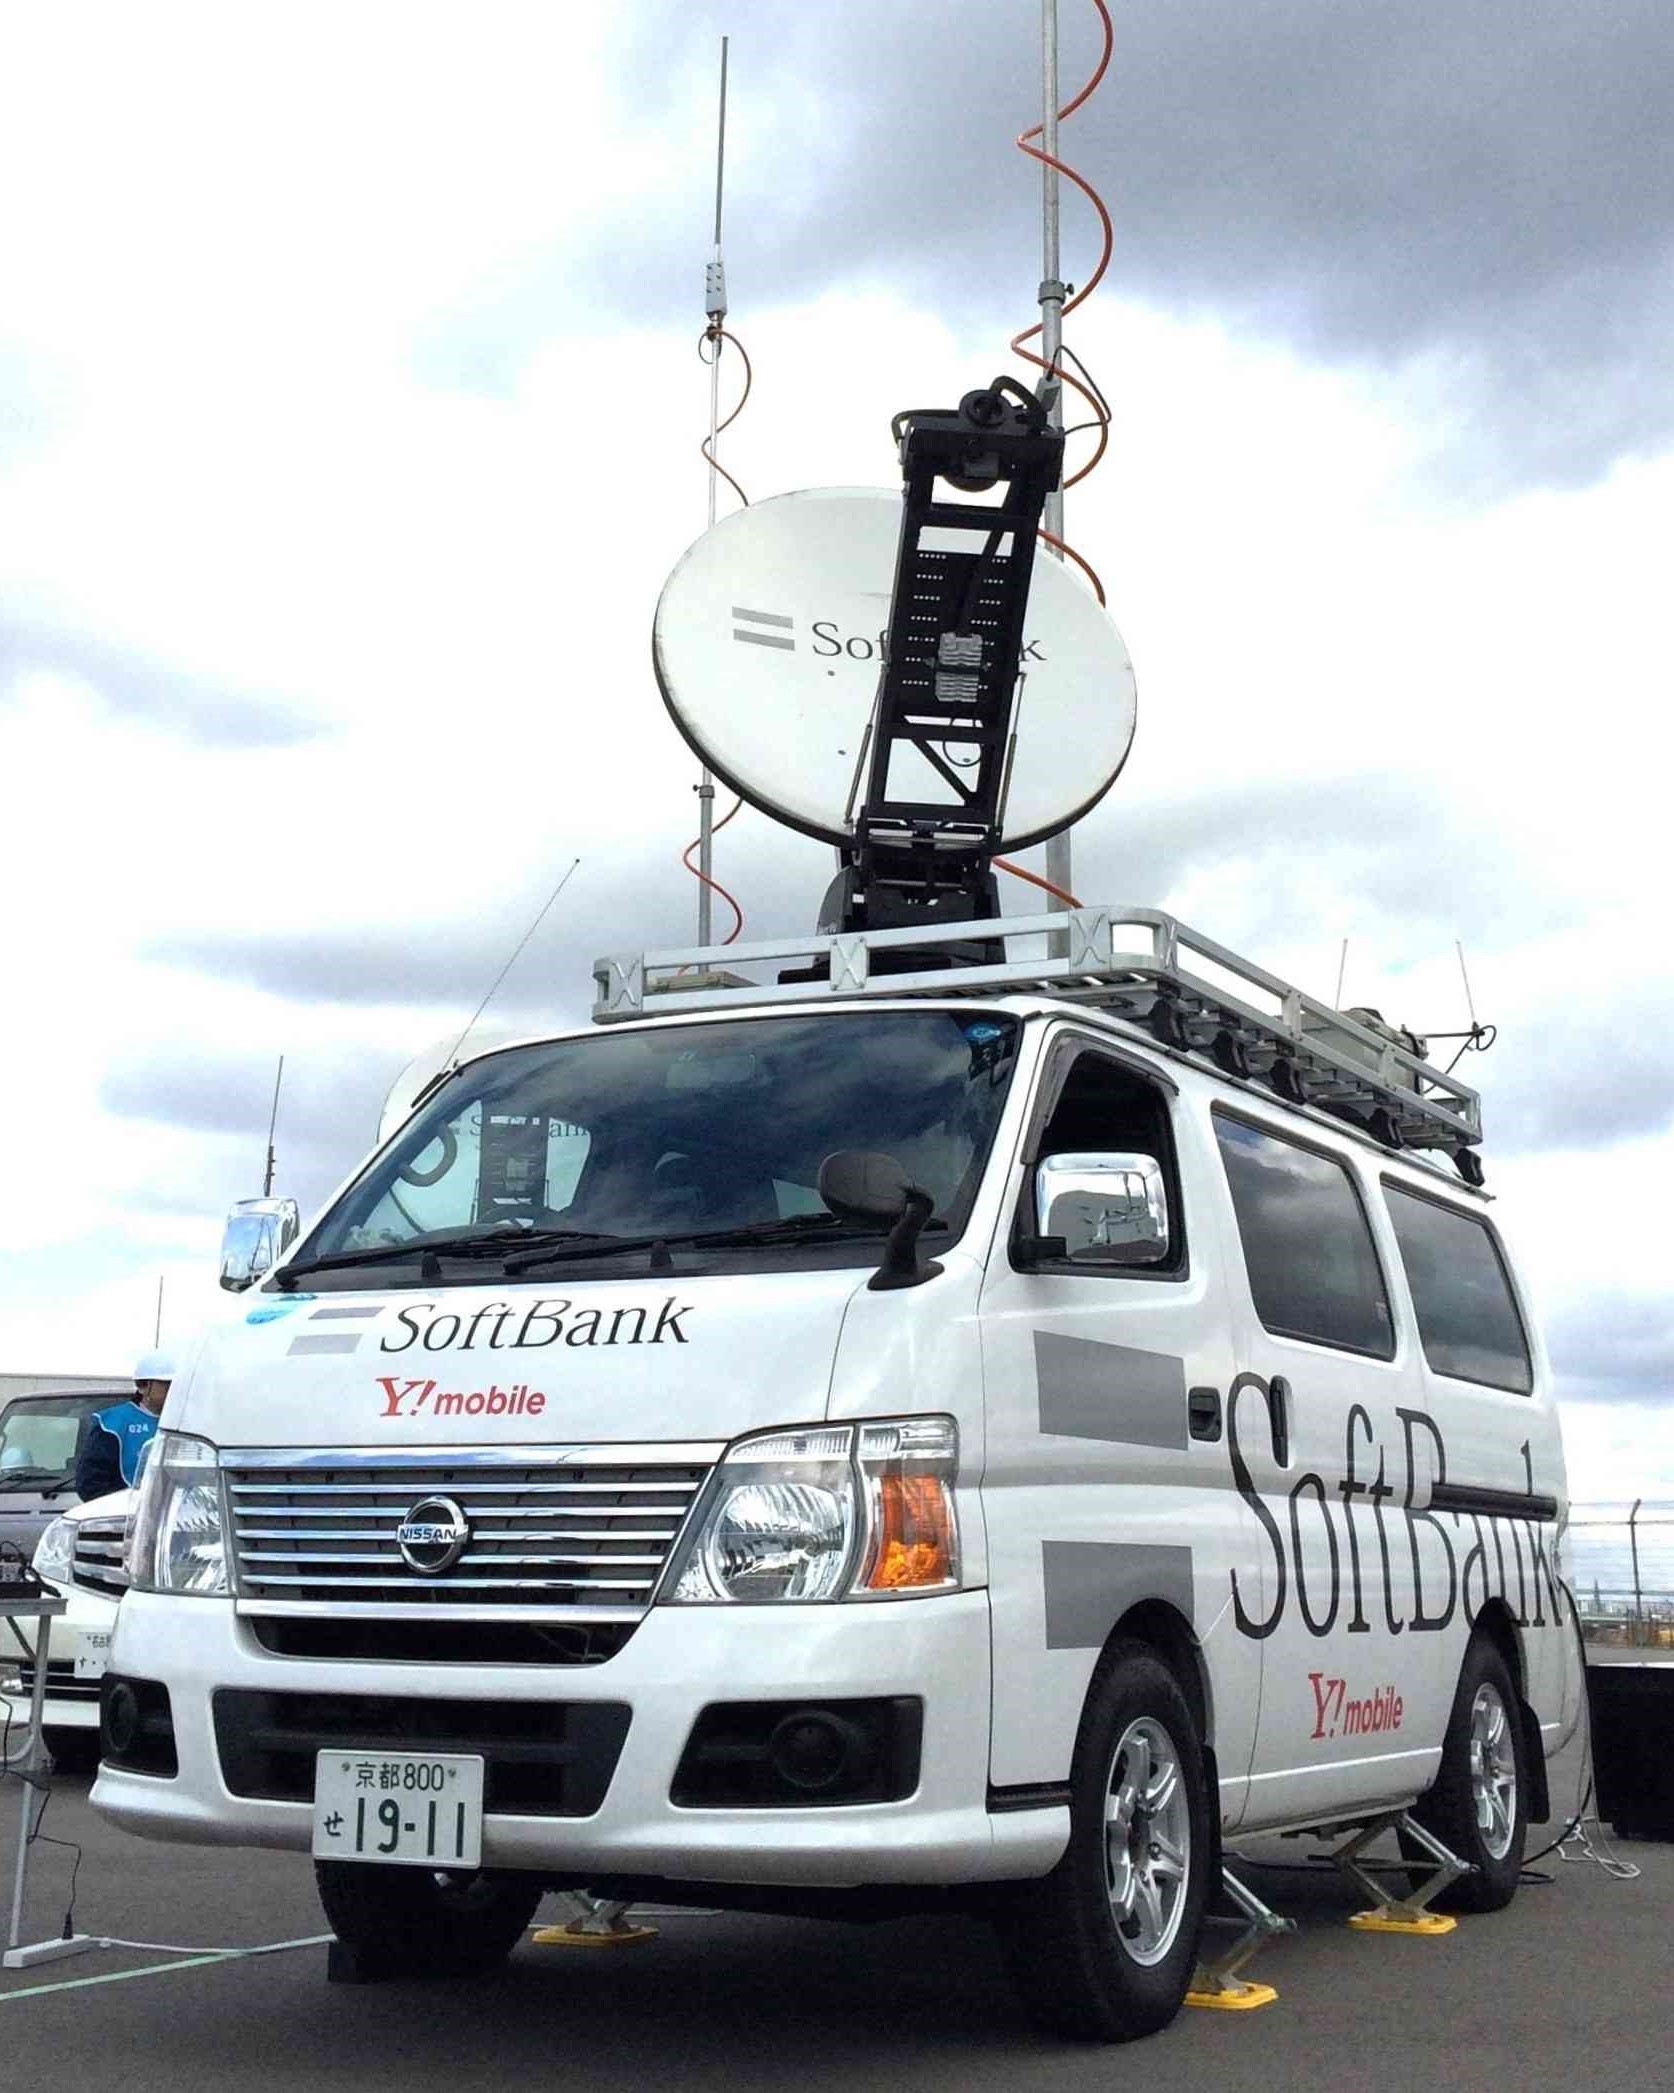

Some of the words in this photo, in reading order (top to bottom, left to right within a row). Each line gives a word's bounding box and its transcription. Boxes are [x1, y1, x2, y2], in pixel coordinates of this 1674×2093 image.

[380, 1296, 694, 1352] SoftBank
[400, 1528, 457, 1540] NISSAN
[323, 1811, 344, 1837] せ
[355, 1797, 465, 1858] 19-11
